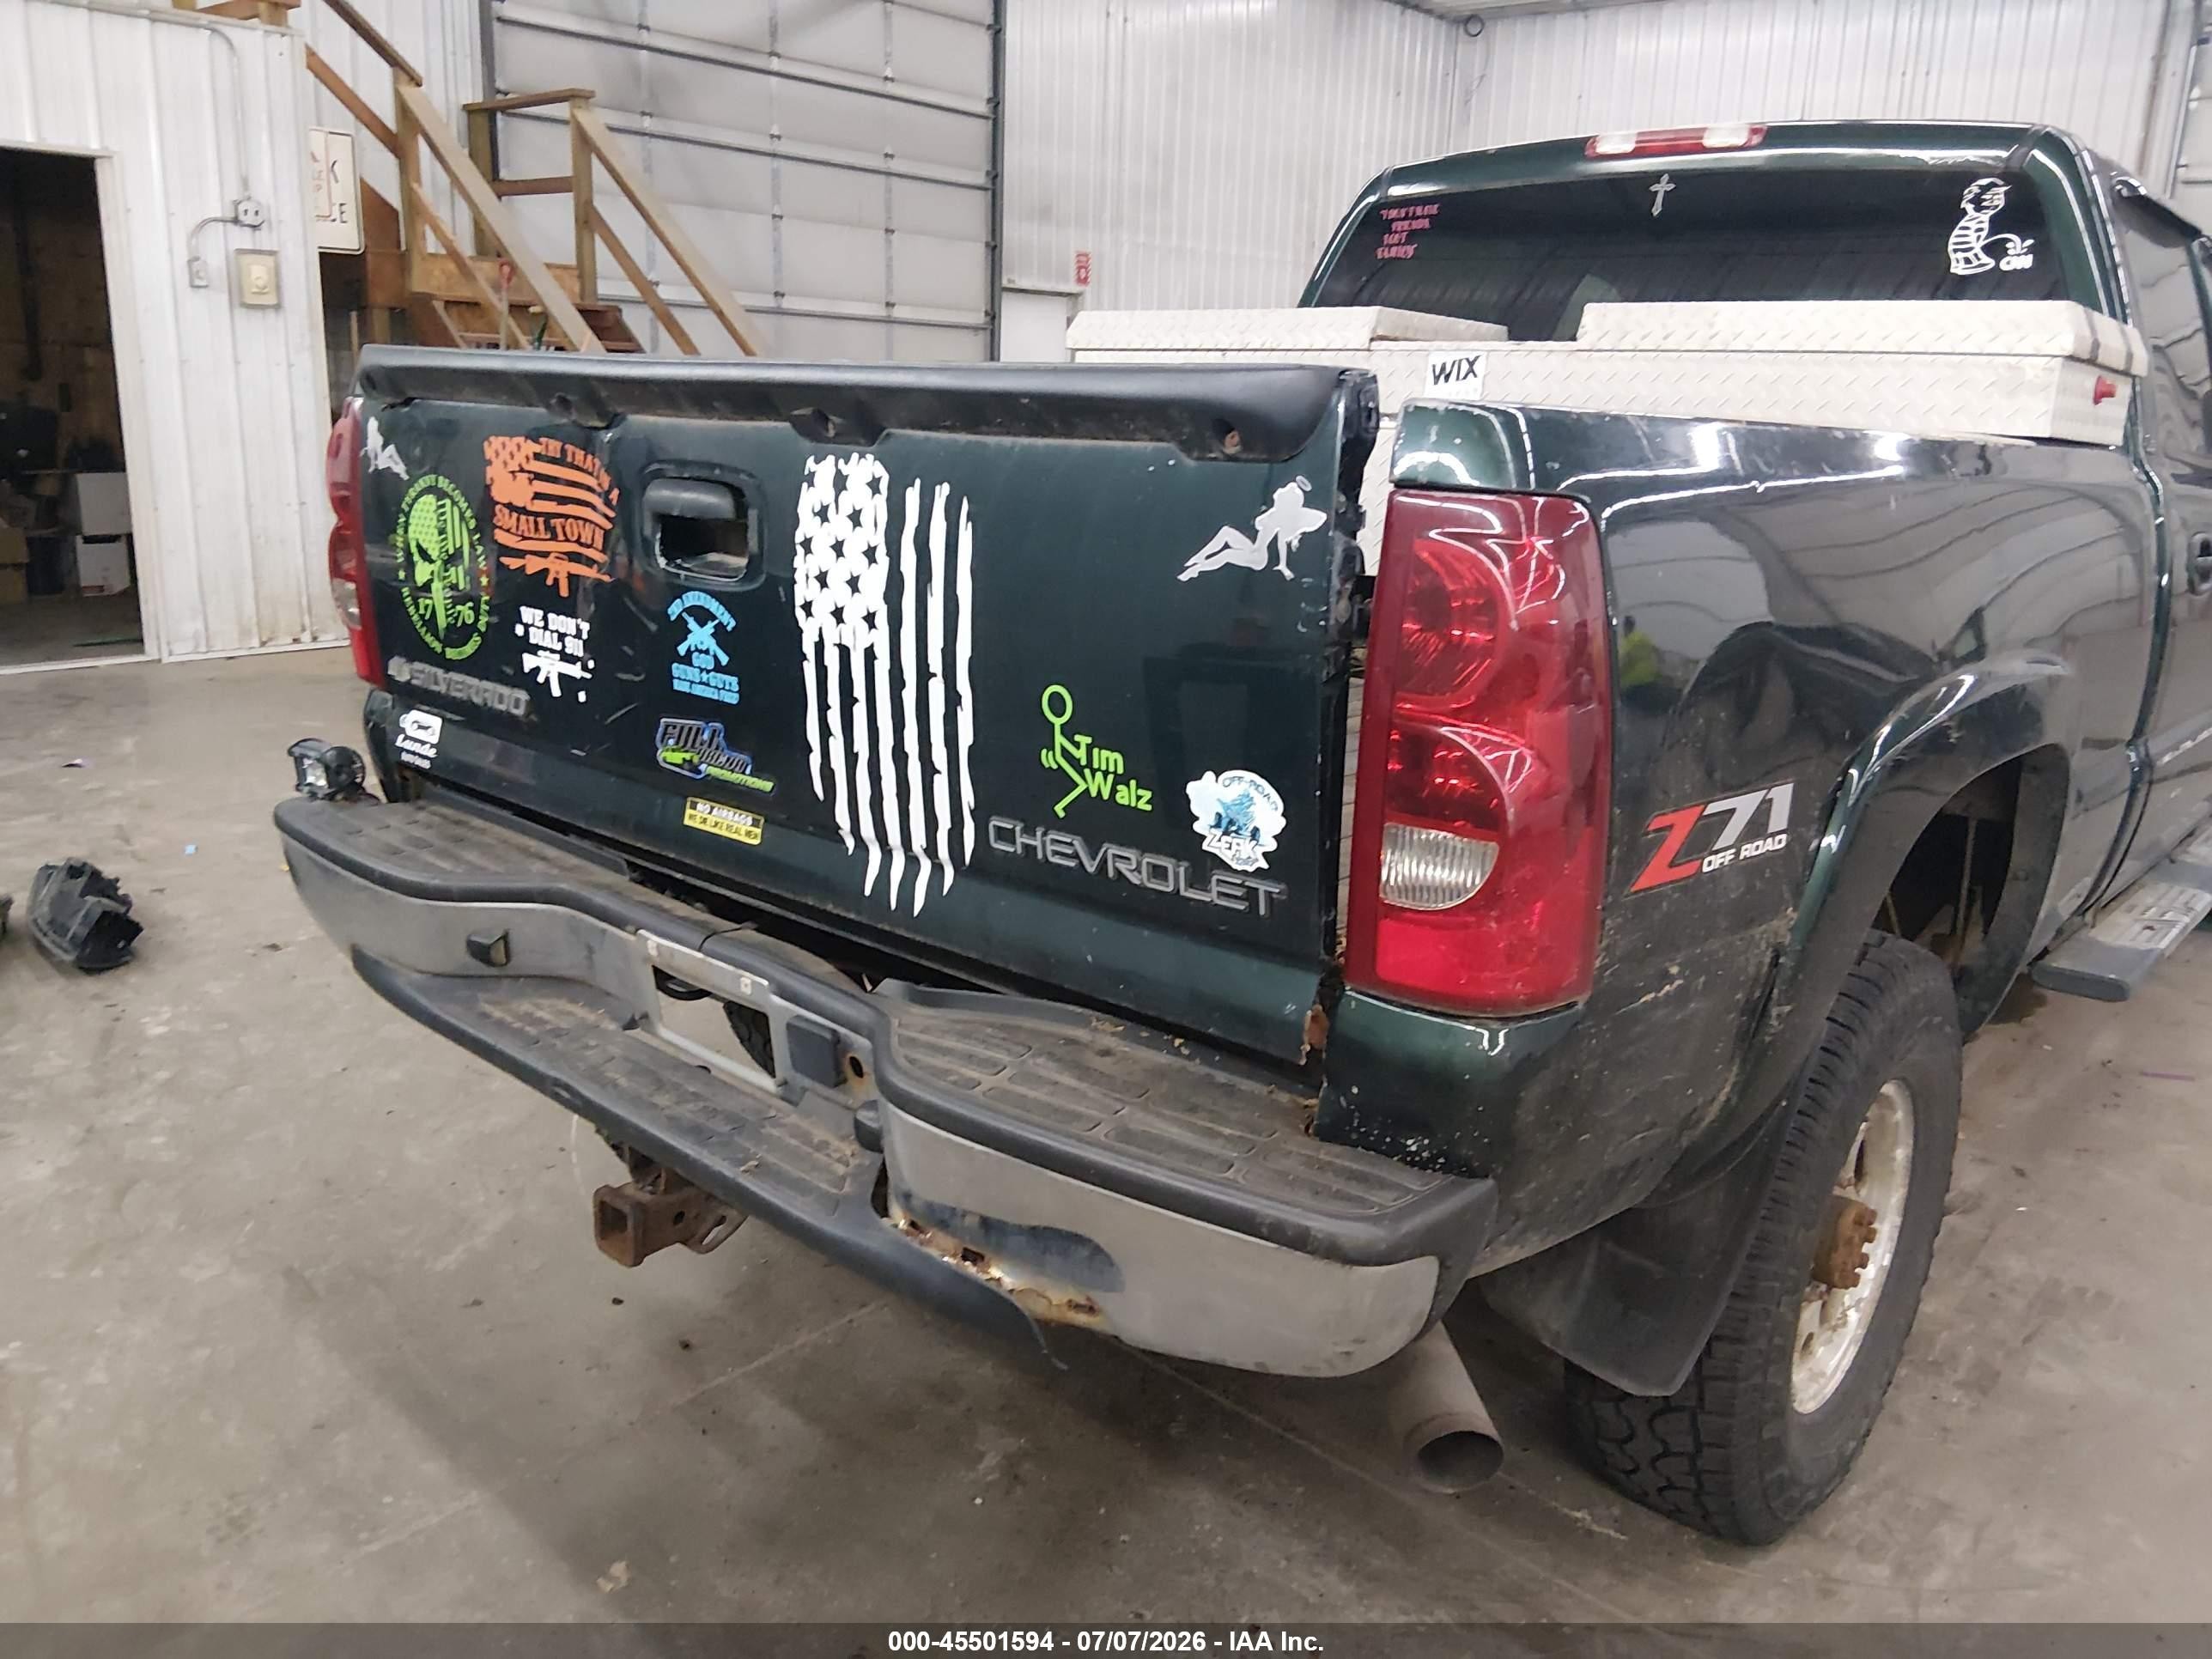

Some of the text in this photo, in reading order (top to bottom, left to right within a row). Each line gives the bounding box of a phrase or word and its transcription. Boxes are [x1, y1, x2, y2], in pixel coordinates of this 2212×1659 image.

[1431, 355, 1481, 386] WIX
[563, 443, 601, 477] THAT
[608, 487, 620, 507] A
[493, 504, 605, 550] SMALL TOWN
[471, 532, 488, 568] LAW
[417, 598, 476, 627] 17 76
[520, 606, 590, 641] WE DON'T
[529, 627, 562, 651] DIAL
[410, 661, 531, 718] SILVERADO
[1074, 733, 1125, 775] Tim
[696, 801, 711, 816] NO
[1084, 768, 1153, 811] Walz
[1630, 782, 1795, 894] Z71
[1702, 833, 1789, 874] OFF ROAD
[988, 817, 1283, 917] CHEVROLET
